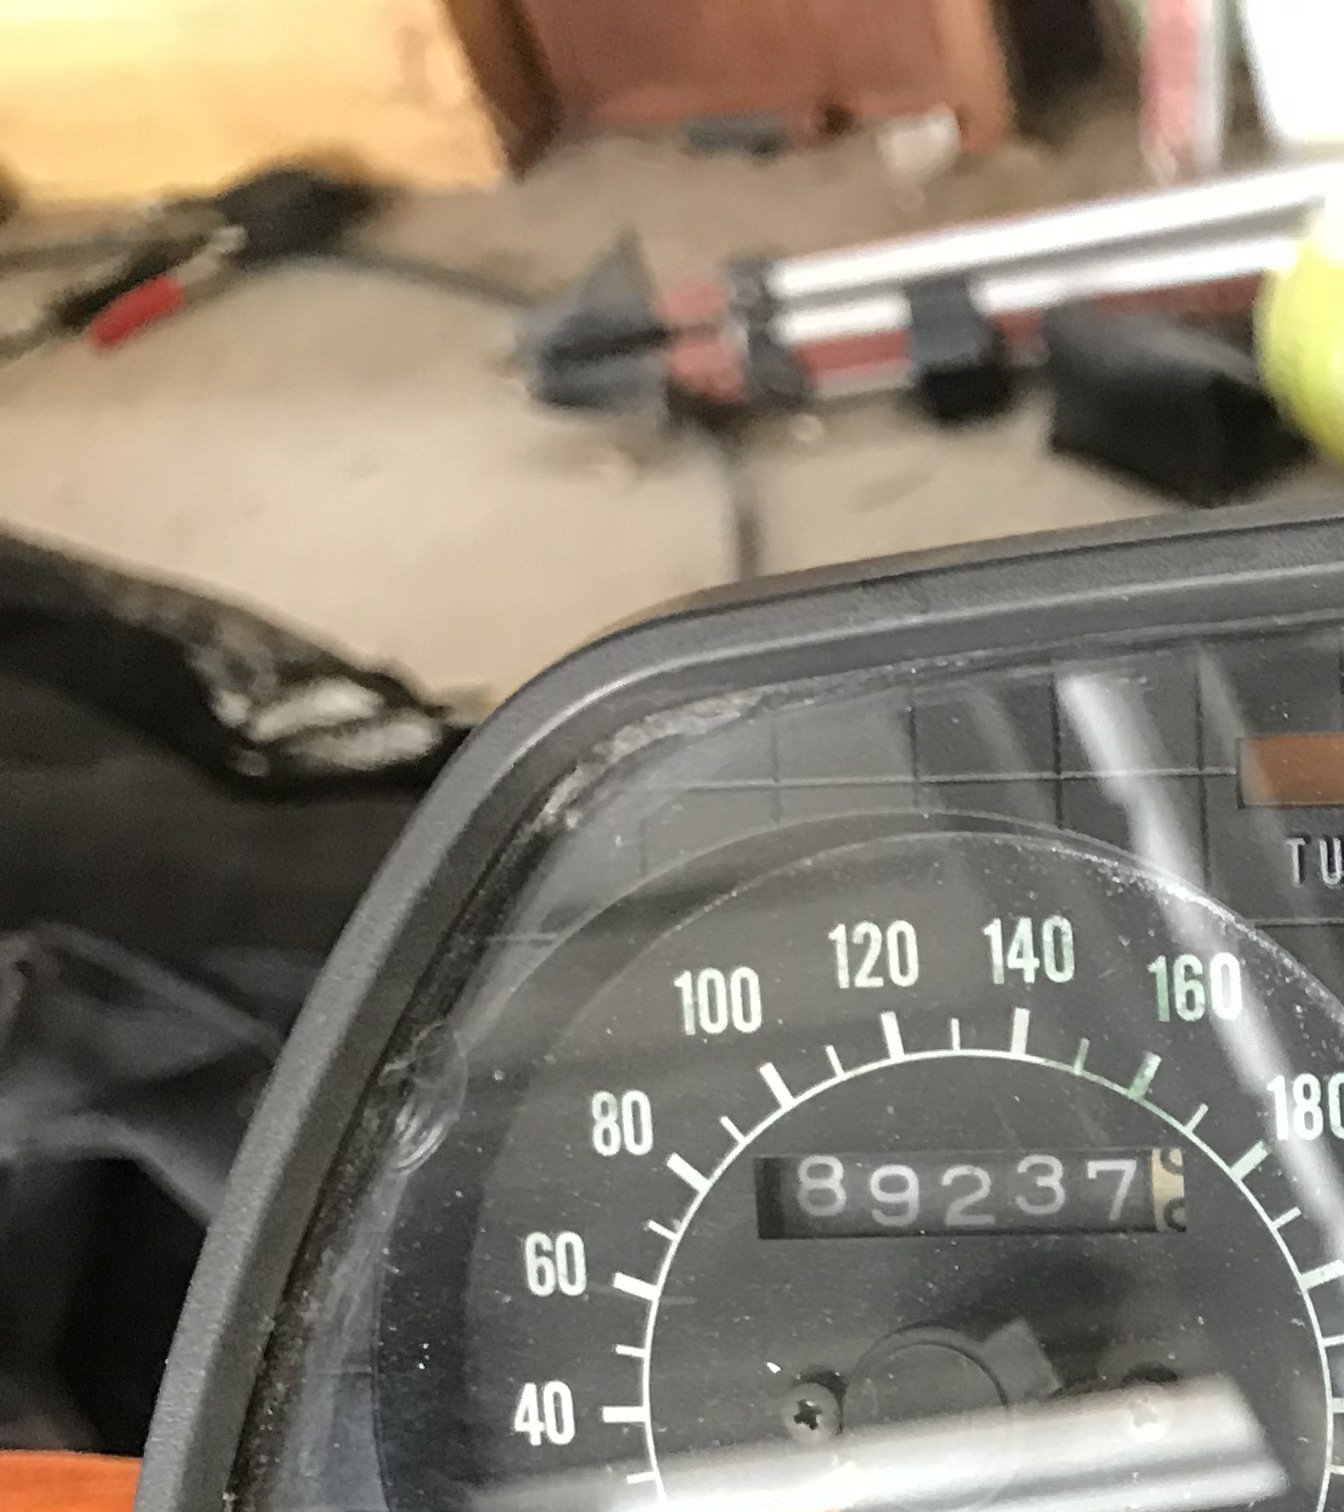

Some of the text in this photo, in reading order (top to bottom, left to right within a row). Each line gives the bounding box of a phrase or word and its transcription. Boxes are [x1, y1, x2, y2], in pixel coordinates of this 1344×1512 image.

[828, 920, 919, 989] 120
[982, 915, 1076, 985] 140
[673, 966, 763, 1036] 100
[1147, 951, 1244, 1022] 160
[591, 1089, 654, 1156] 80
[524, 1231, 588, 1297] 60
[513, 1380, 576, 1446] 40
